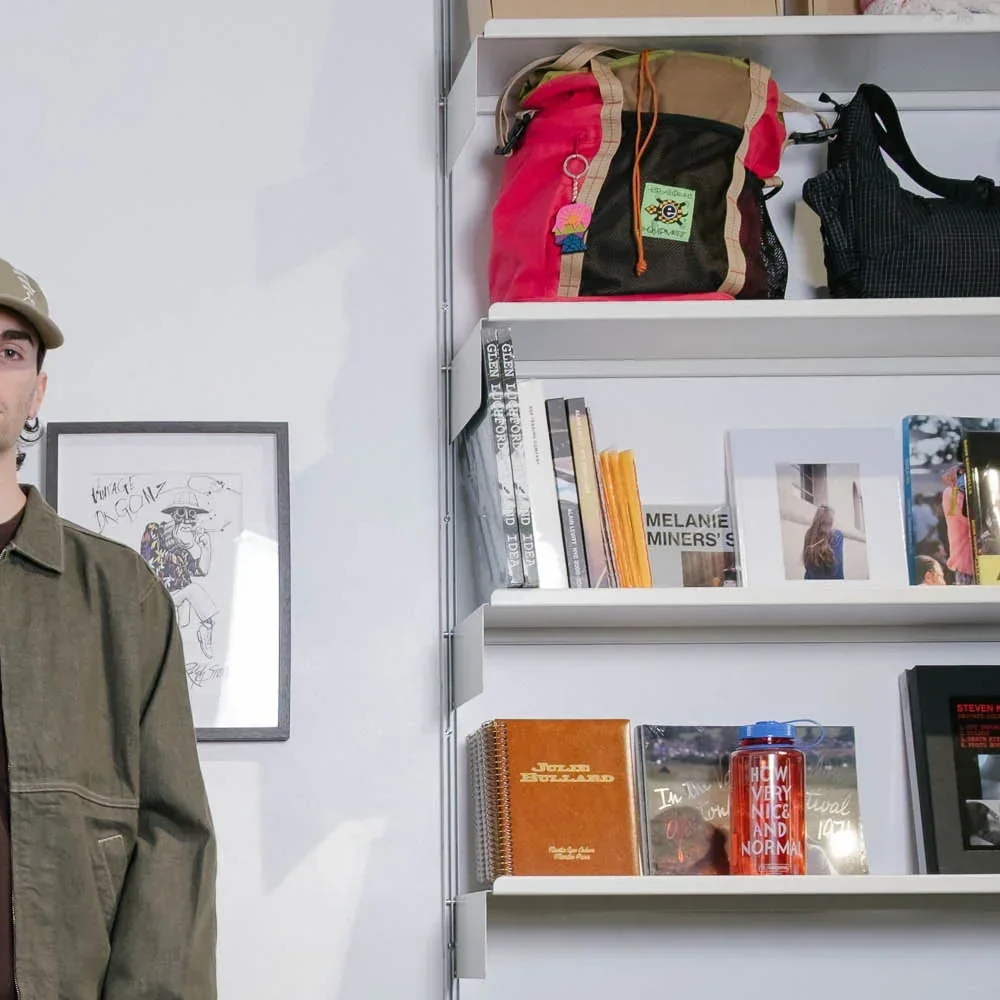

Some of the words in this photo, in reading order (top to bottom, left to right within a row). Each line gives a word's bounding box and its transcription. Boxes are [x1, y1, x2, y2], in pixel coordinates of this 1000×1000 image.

[646, 513, 729, 528] MELANIE
[523, 535, 536, 567] IDEA
[751, 766, 788, 782] HOW
[751, 785, 792, 801] VERY
[753, 822, 787, 838] AND
